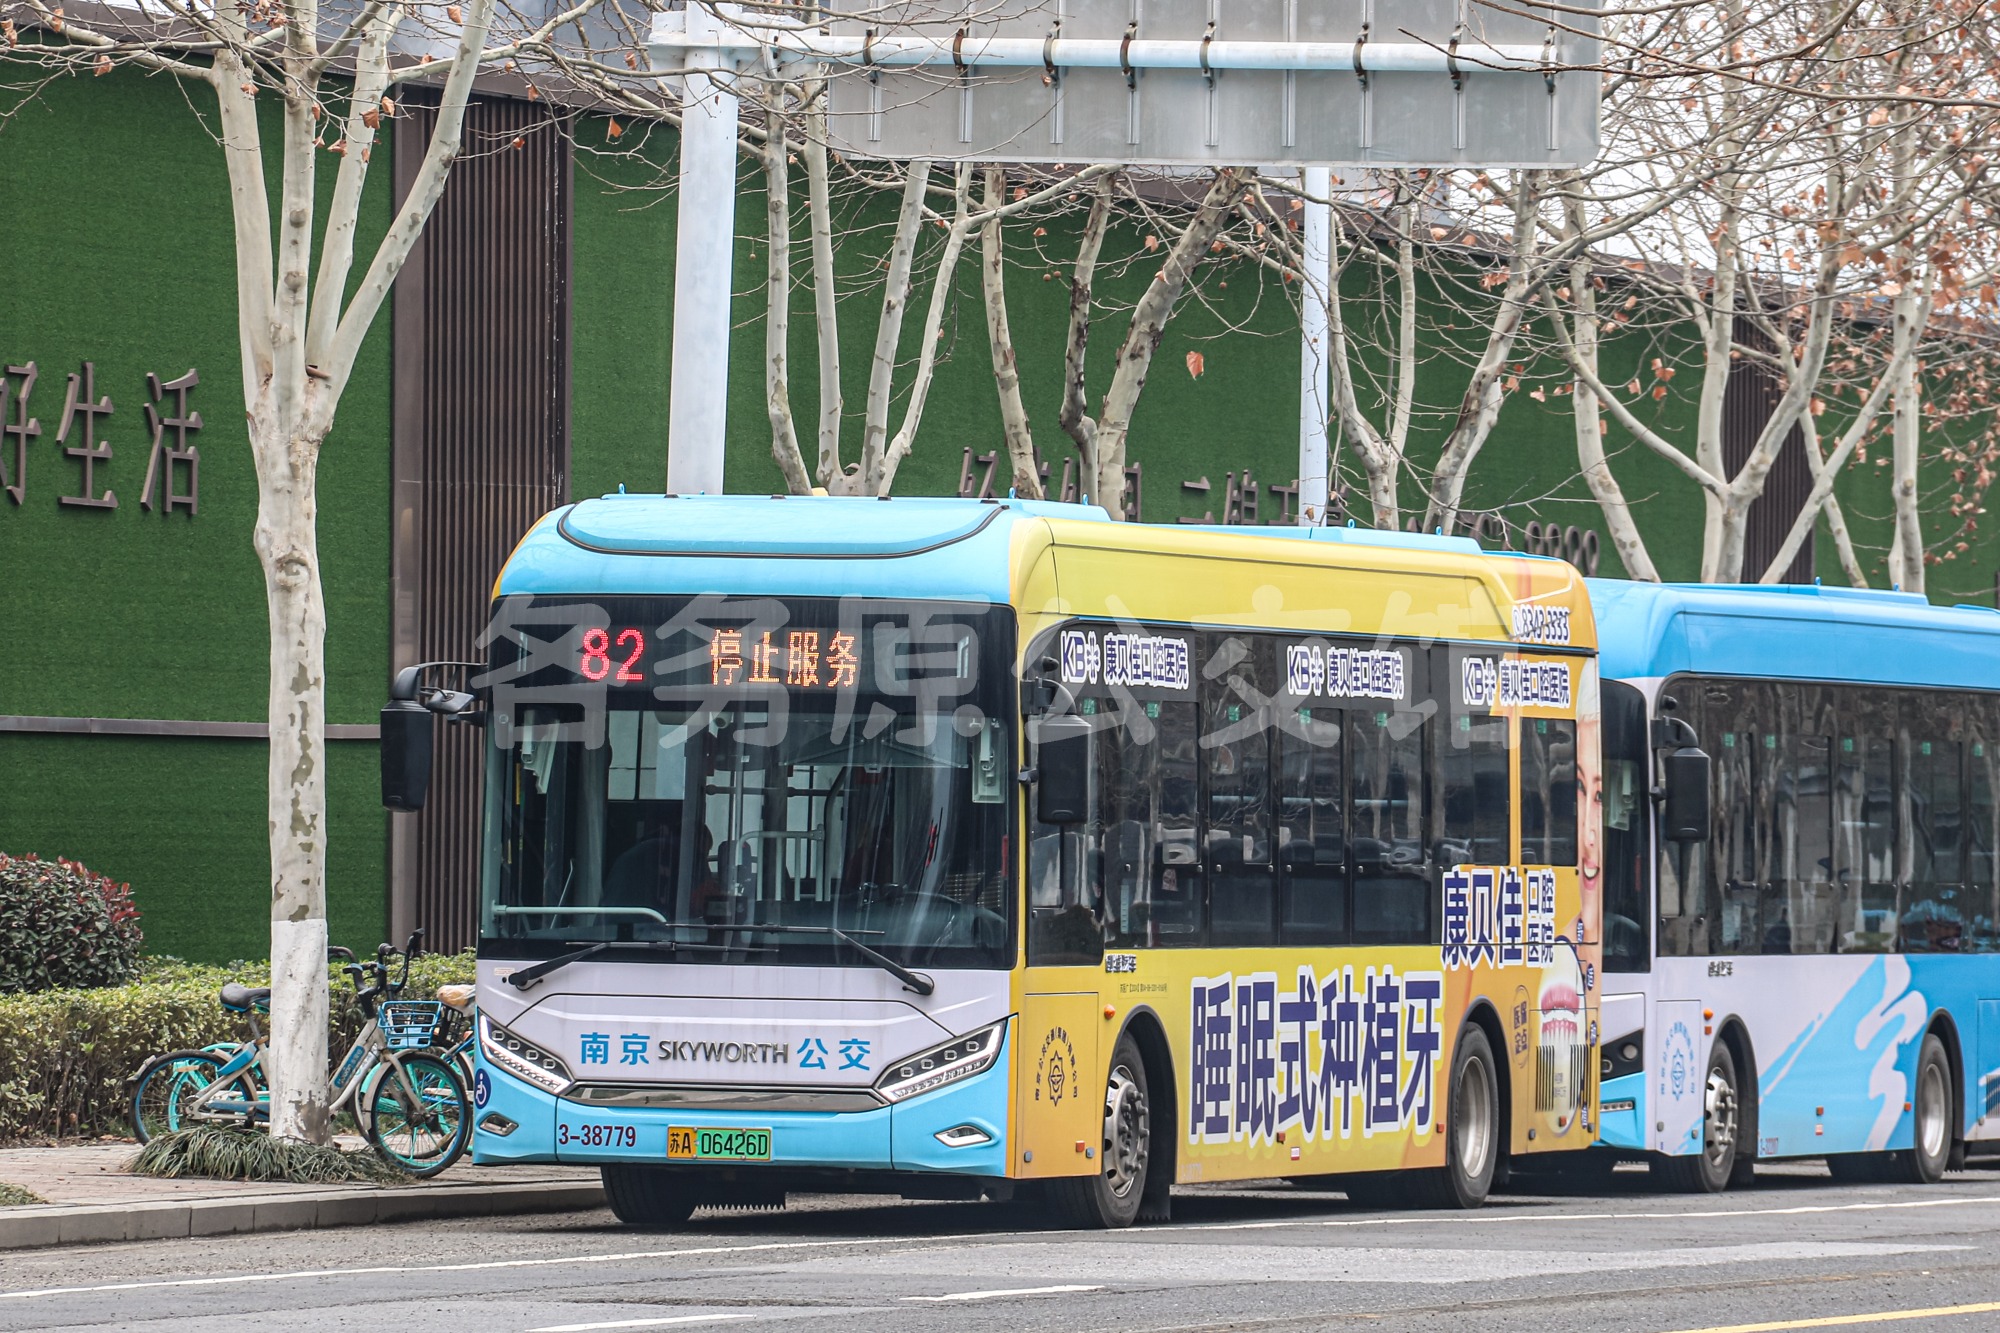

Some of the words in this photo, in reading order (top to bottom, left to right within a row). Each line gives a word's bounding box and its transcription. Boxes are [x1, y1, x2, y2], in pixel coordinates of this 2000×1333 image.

[581, 628, 644, 680] 82
[710, 629, 858, 687] 停止服务
[1061, 632, 1085, 681] KB
[1104, 634, 1188, 687] 康贝佳口腔医院
[1288, 647, 1312, 693] KB
[1328, 649, 1403, 697] 康贝佳口腔医院
[1463, 659, 1484, 704] KB
[1499, 661, 1569, 706] 康贝佳口腔医院
[1443, 868, 1522, 969] 康贝佳
[580, 1032, 650, 1066] 南京
[658, 1040, 788, 1063] SKYWORTH
[797, 1038, 870, 1071] 公交
[1191, 974, 1440, 1140] 睡眠式种植牙
[558, 1123, 636, 1147] 3-38779
[701, 1133, 768, 1156] 06426D
